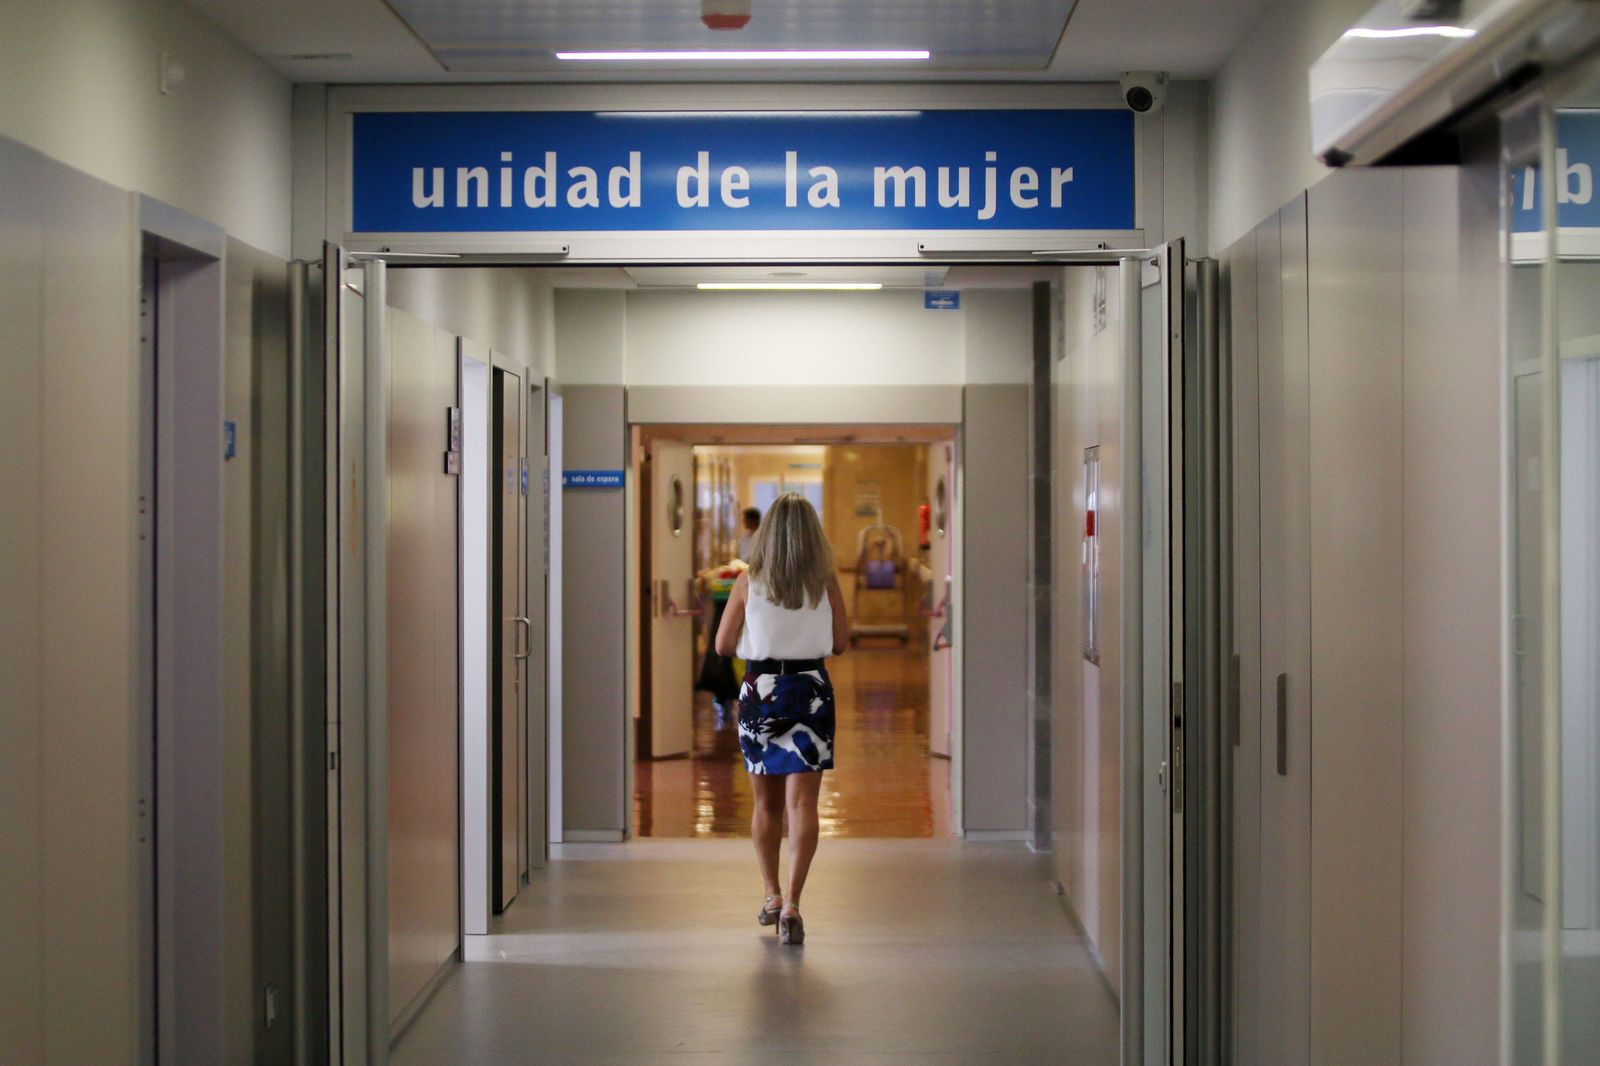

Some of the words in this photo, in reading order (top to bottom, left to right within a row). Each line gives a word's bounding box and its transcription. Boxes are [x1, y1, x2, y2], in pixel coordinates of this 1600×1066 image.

[413, 151, 642, 208] unidad
[676, 151, 750, 209] de
[785, 151, 841, 208] la
[873, 151, 1074, 220] mujer
[596, 476, 619, 484] espera
